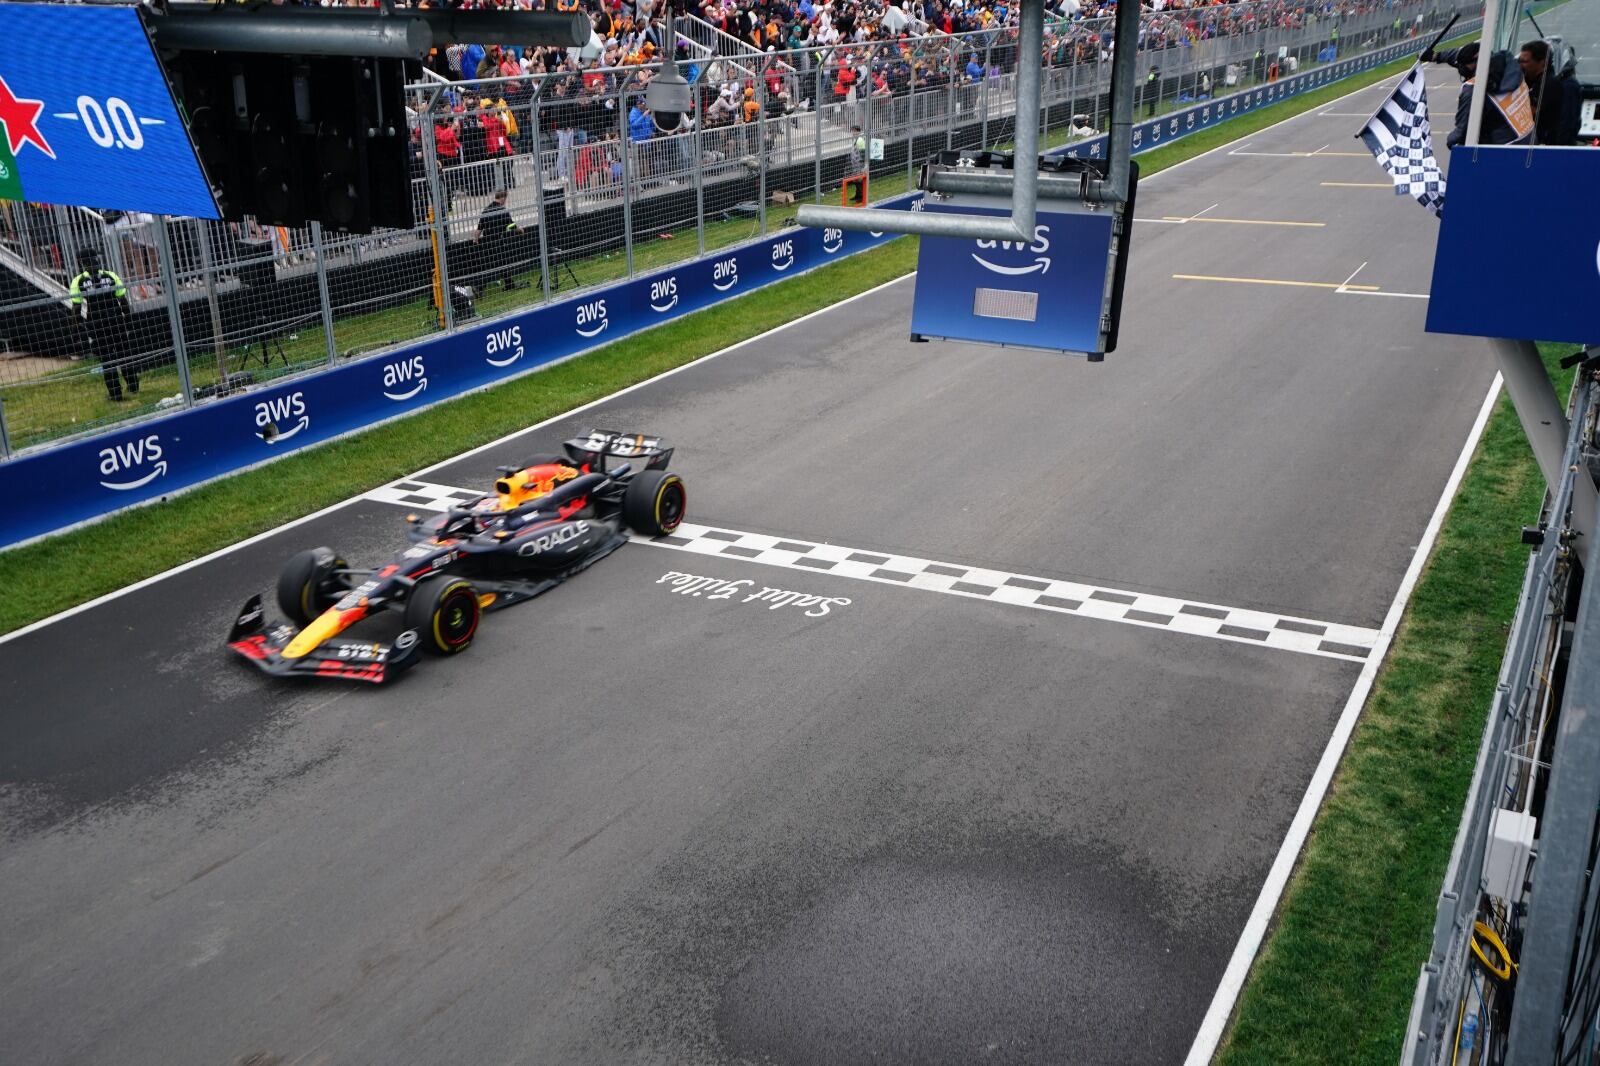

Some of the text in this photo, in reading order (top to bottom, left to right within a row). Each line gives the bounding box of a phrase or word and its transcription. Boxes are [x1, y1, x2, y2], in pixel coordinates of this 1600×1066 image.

[772, 239, 793, 260] aws
[714, 257, 737, 280] aws
[650, 277, 678, 301] aws
[577, 299, 608, 326] aws
[486, 325, 522, 354] aws
[383, 355, 425, 387] aws
[255, 391, 306, 426] aws
[100, 435, 162, 475] aws
[519, 519, 590, 557] ORACLE
[655, 570, 852, 617] Salut Gilles
